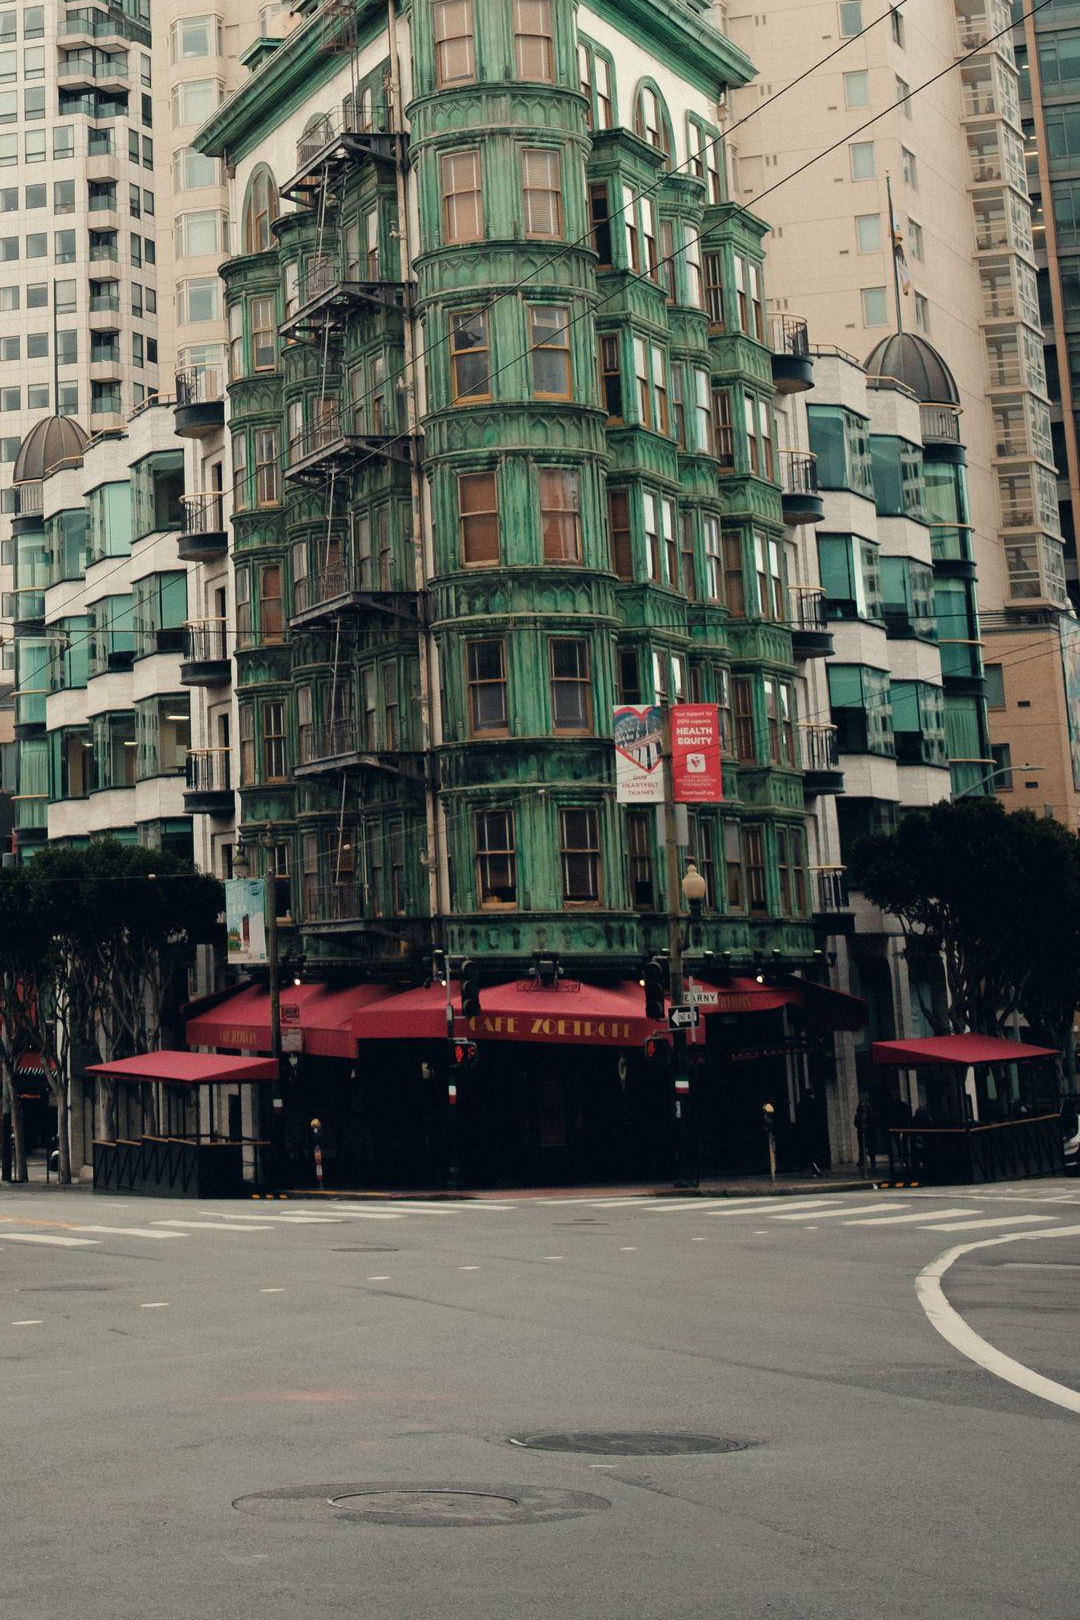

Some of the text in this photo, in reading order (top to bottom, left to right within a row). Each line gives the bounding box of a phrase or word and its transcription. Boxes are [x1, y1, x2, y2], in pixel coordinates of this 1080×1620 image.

[676, 726, 713, 735] HEALTH
[677, 736, 713, 745] EQUITY
[684, 993, 716, 1002] EARNY
[469, 1015, 633, 1039] CAFE ZOETROPE
